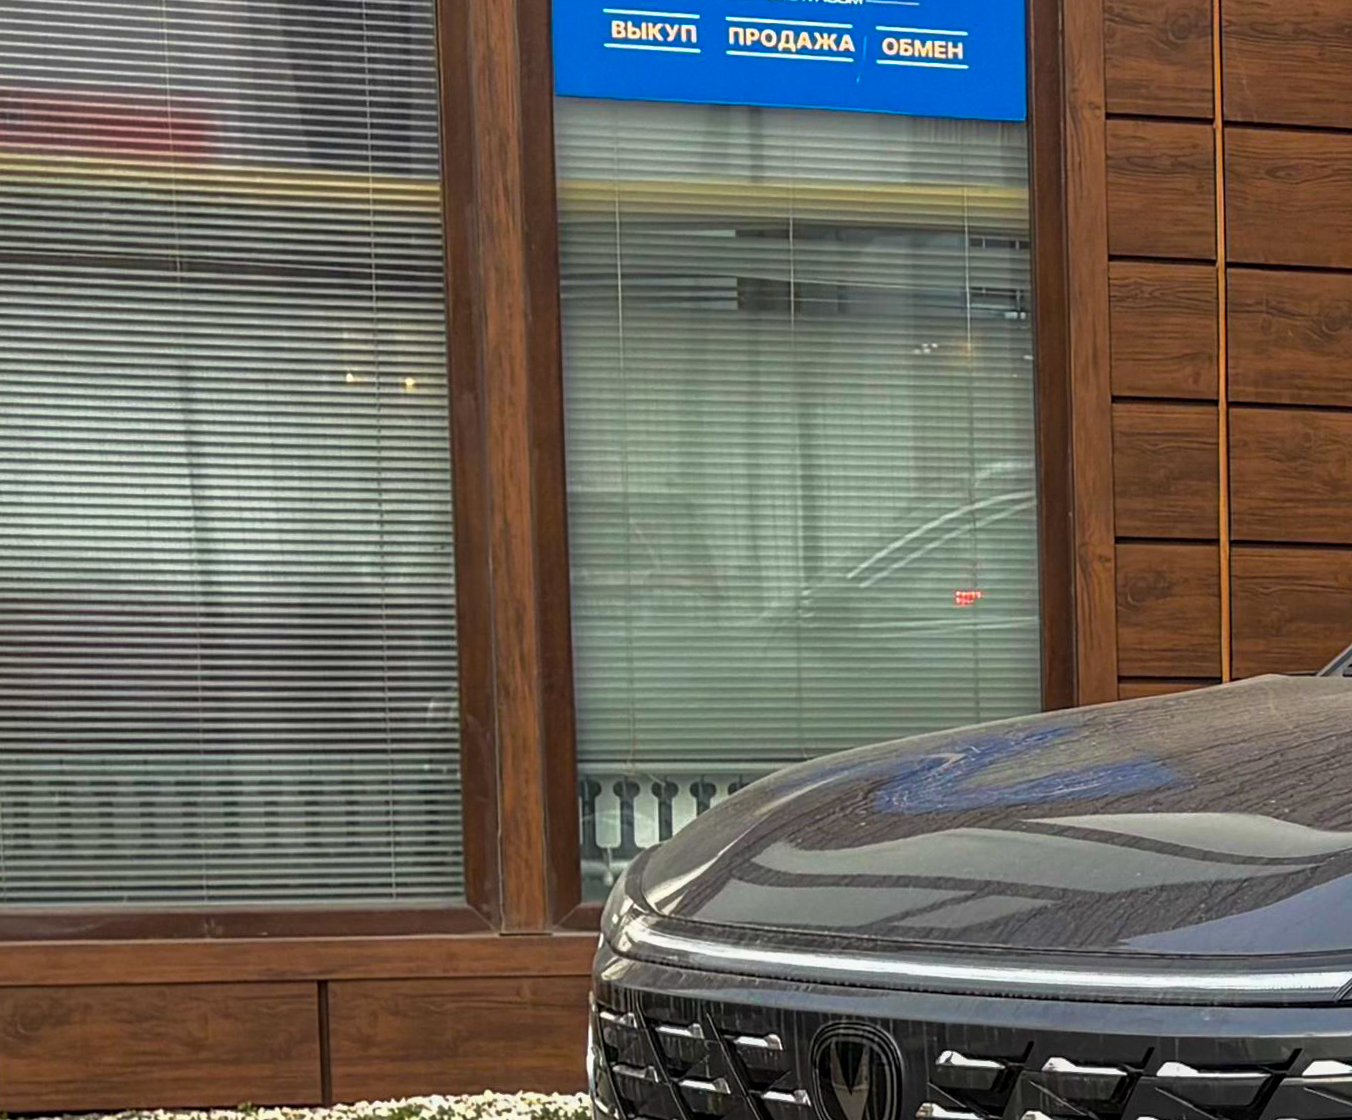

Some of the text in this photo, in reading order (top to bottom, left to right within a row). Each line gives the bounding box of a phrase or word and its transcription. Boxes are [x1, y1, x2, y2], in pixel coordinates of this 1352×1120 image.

[611, 20, 964, 60] ВЫКУП ПРОДАЖА ОБМЕН
